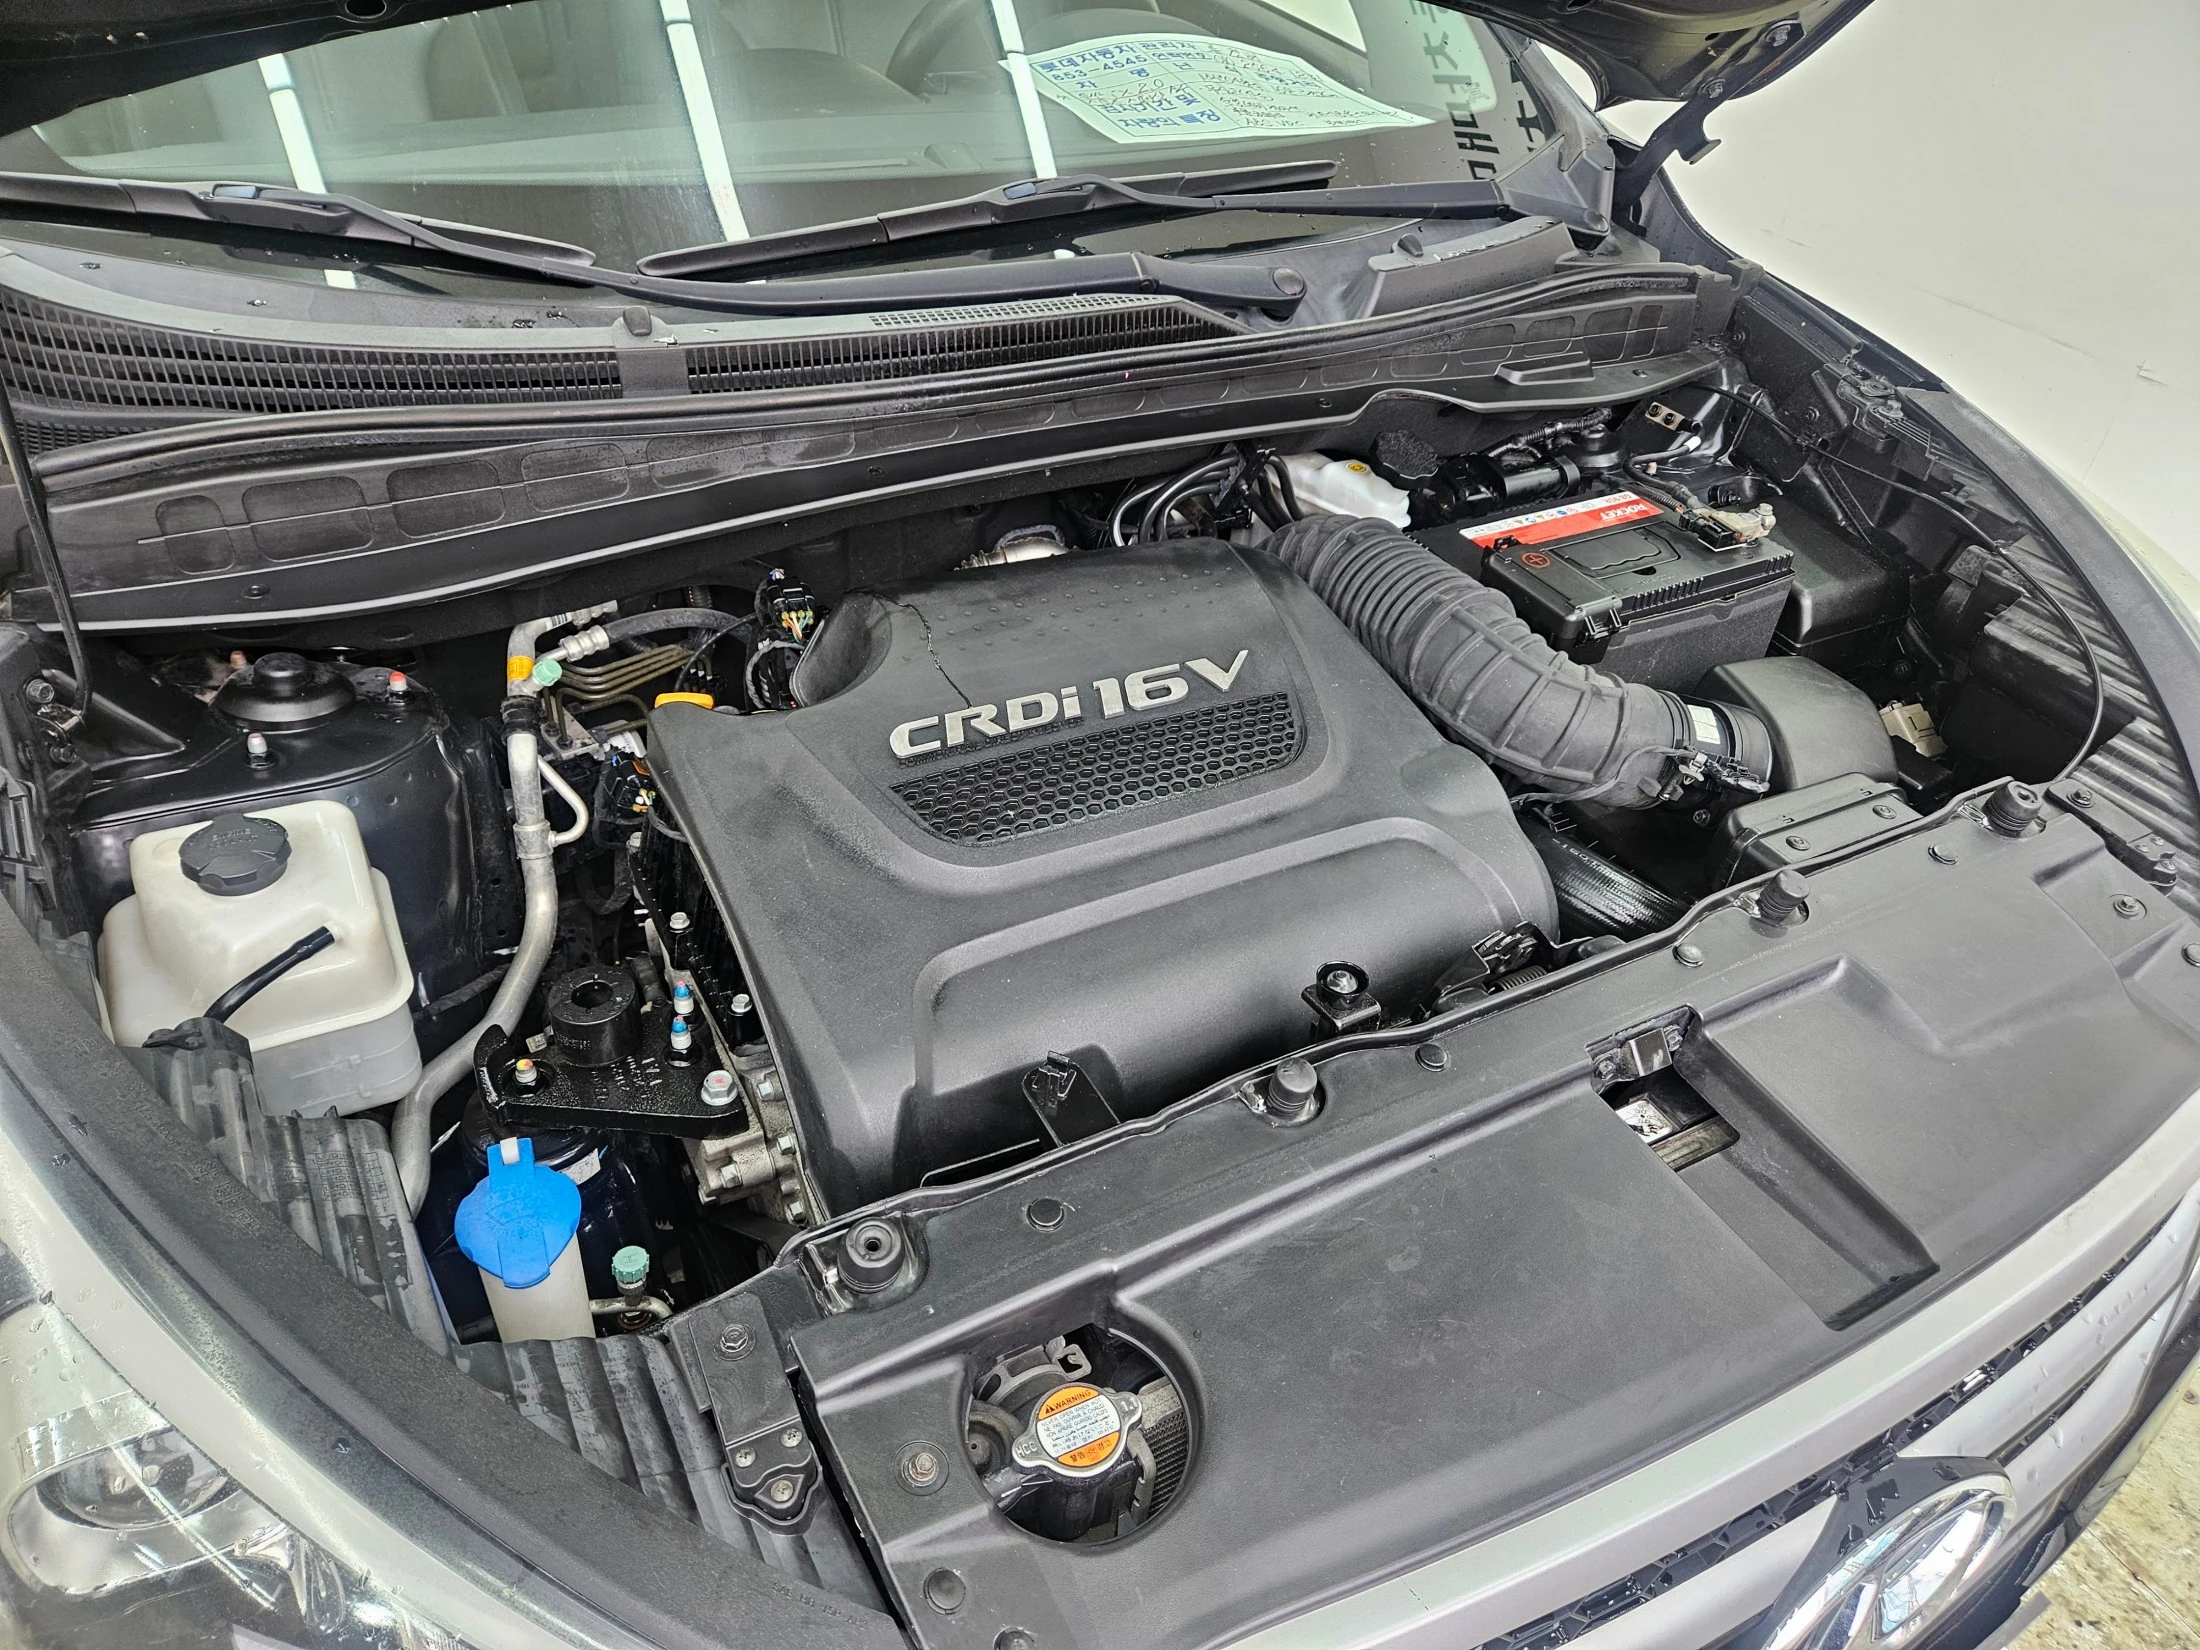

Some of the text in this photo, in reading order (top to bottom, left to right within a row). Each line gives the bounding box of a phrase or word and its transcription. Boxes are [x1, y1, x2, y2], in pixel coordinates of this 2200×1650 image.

[1038, 44, 1136, 72] 롯데자동차
[1600, 503, 1646, 520] ROCKET
[890, 650, 1248, 758] CRDi 16V
[1055, 1390, 1091, 1409] WARNING
[1041, 1416, 1058, 1427] NEVER
[1060, 1410, 1074, 1421] OPEN
[1075, 1404, 1089, 1415] WHEN
[1053, 1420, 1063, 1429] PAS
[1046, 1430, 1057, 1439] NON
[1074, 1415, 1092, 1427] QUANDO
[1016, 1442, 1038, 1458] HCC
